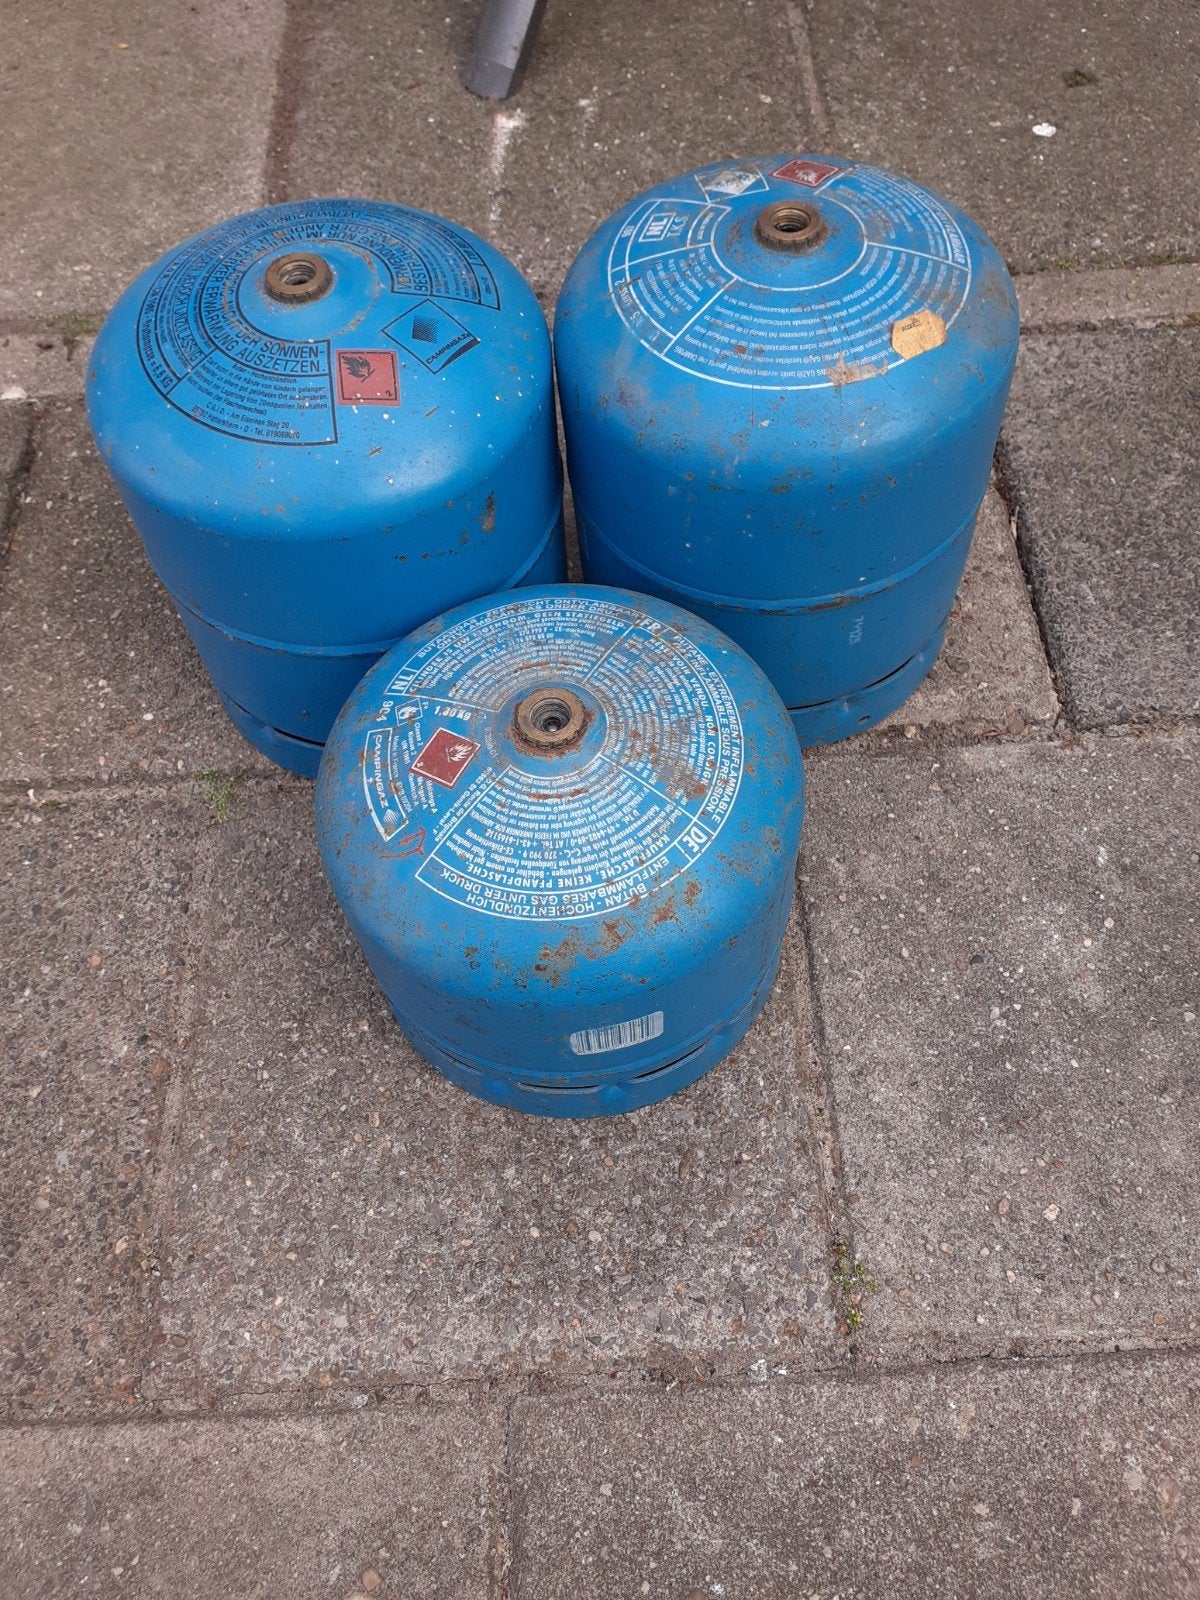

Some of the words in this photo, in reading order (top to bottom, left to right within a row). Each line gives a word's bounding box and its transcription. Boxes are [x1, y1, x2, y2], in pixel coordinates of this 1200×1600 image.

[305, 230, 324, 239] IM
[642, 217, 671, 237] NL
[262, 338, 326, 367] SONNEN-
[426, 333, 467, 364] CAMPINGAZ
[158, 374, 173, 389] KG
[273, 383, 297, 392] Kindern
[278, 392, 288, 400] Ort
[230, 411, 240, 420] Am
[280, 421, 290, 429] 20
[254, 426, 265, 437] Tel.
[517, 604, 542, 613] GAS
[638, 616, 662, 632] FR
[417, 617, 478, 658] BUTAANGAS
[441, 647, 454, 656] IS
[452, 635, 471, 648] UW
[534, 611, 560, 619] GEEN
[671, 634, 709, 666] BUTANE
[390, 671, 415, 690] NL
[687, 658, 729, 724] INFLAMMABLE
[688, 677, 712, 710] VENDU.
[704, 715, 717, 736] NON
[706, 670, 742, 745] EXTRÊMEMENT
[719, 726, 731, 757] SOUS
[373, 734, 390, 808] CAMPINGAZ
[467, 781, 478, 793] St
[704, 757, 730, 814] PRESSION
[710, 746, 740, 825] INFLAMMABLE
[454, 806, 465, 817] de
[620, 812, 635, 826] Tel.
[433, 813, 458, 844] Brignais
[554, 840, 564, 849] AT
[591, 838, 610, 852] reich
[641, 835, 654, 848] die
[681, 825, 708, 853] DE
[543, 850, 557, 860] 270
[581, 844, 592, 855] an
[598, 849, 610, 861] der
[472, 854, 486, 868] gut
[483, 860, 505, 874] einem
[558, 859, 570, 870] von
[583, 859, 611, 875] Kindern
[609, 854, 623, 866] von
[461, 860, 552, 889] PFANDFLASCHE.
[504, 867, 515, 877] an
[514, 869, 544, 880] Behälter
[551, 864, 583, 879] gelangen
[561, 854, 670, 905] ENTFLAMMBARES
[438, 866, 482, 895] DRUCK
[557, 873, 592, 888] KEINE
[481, 886, 526, 905] UNTER
[529, 894, 557, 906] GAS
[603, 881, 647, 907] BUTAN
[463, 891, 594, 918] HOCHENTZÜNDLICH
